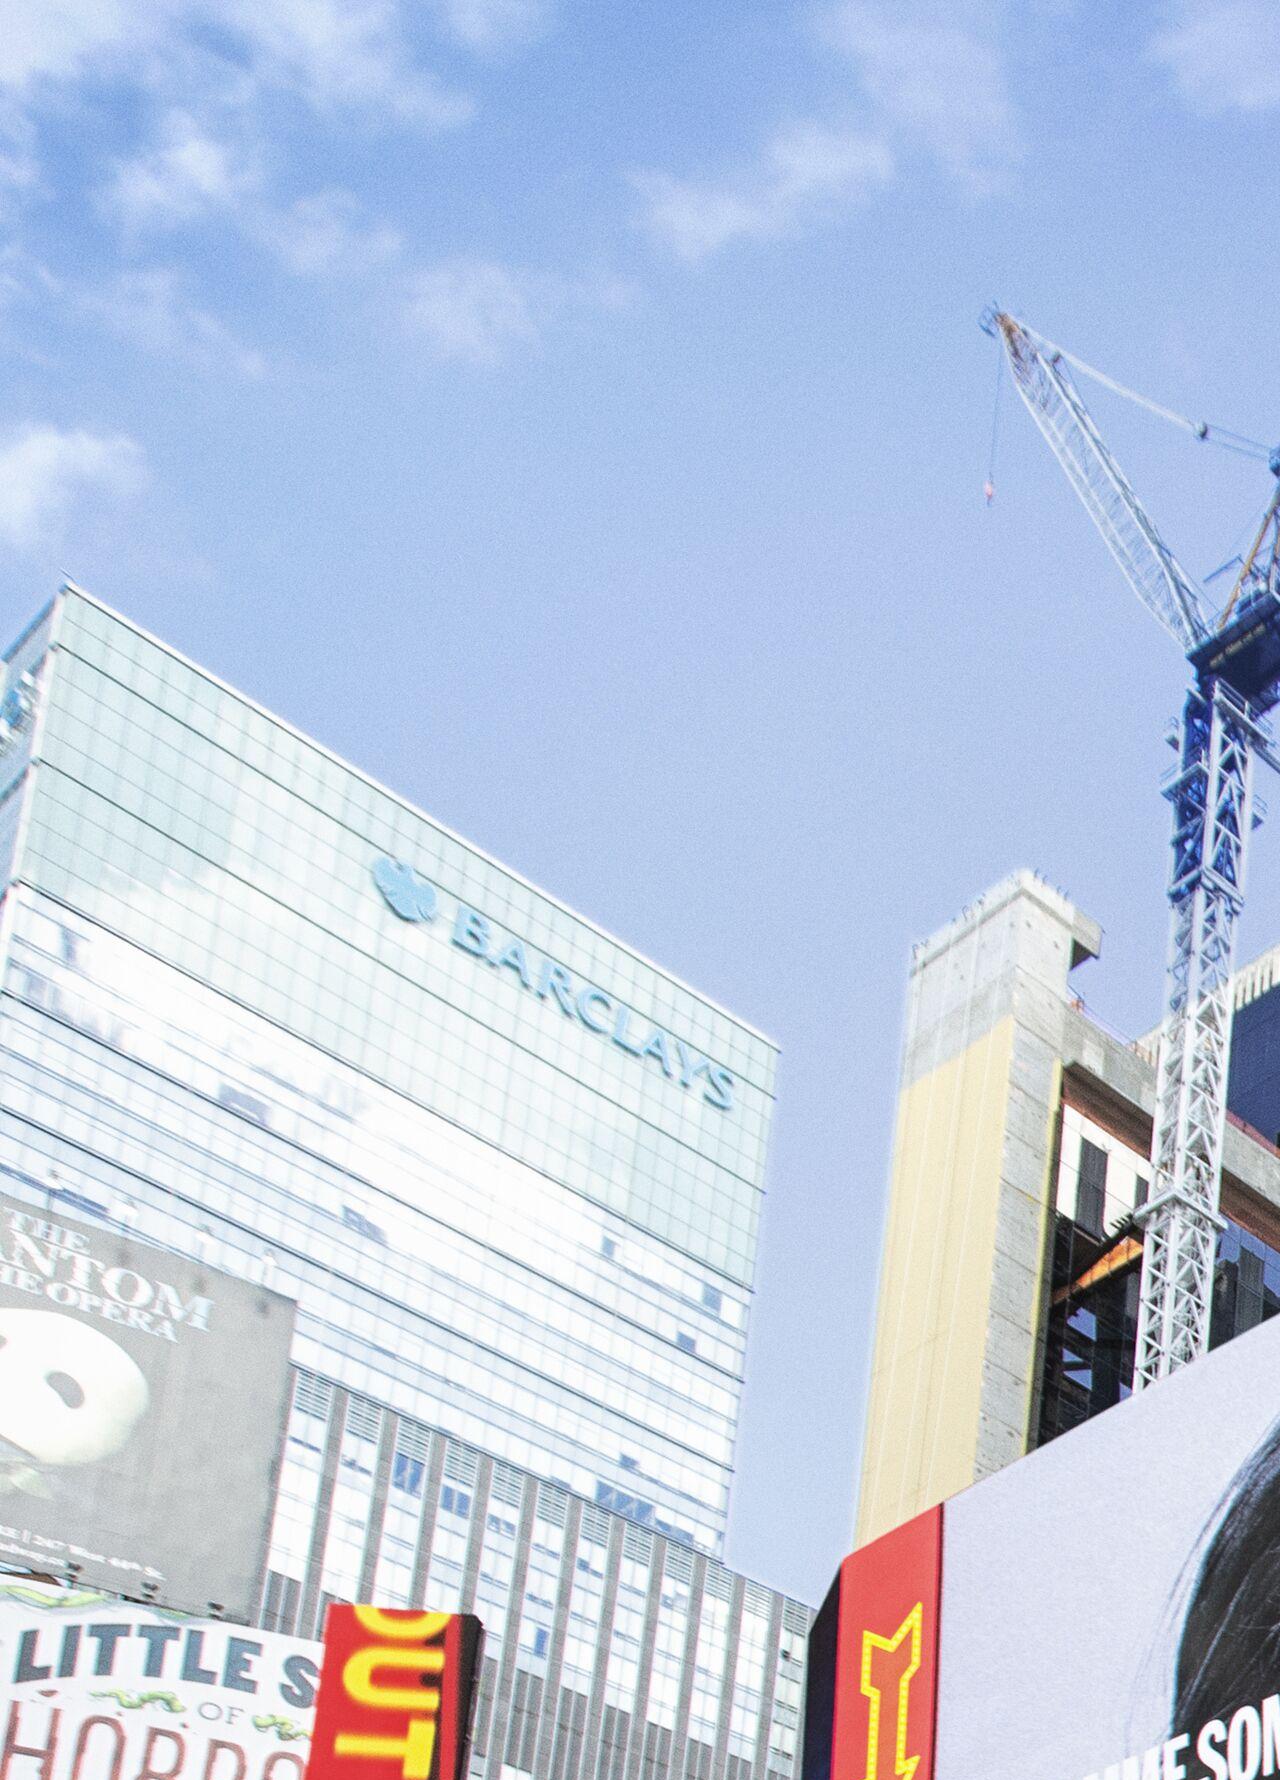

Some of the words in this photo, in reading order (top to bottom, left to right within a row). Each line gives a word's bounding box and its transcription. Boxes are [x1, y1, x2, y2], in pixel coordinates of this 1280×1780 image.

[451, 902, 734, 1110] BARCLAYS
[9, 1210, 91, 1254] THE
[44, 1281, 179, 1343] OPERA
[14, 1623, 263, 1694] LITTLE
[198, 1701, 245, 1728] OF
